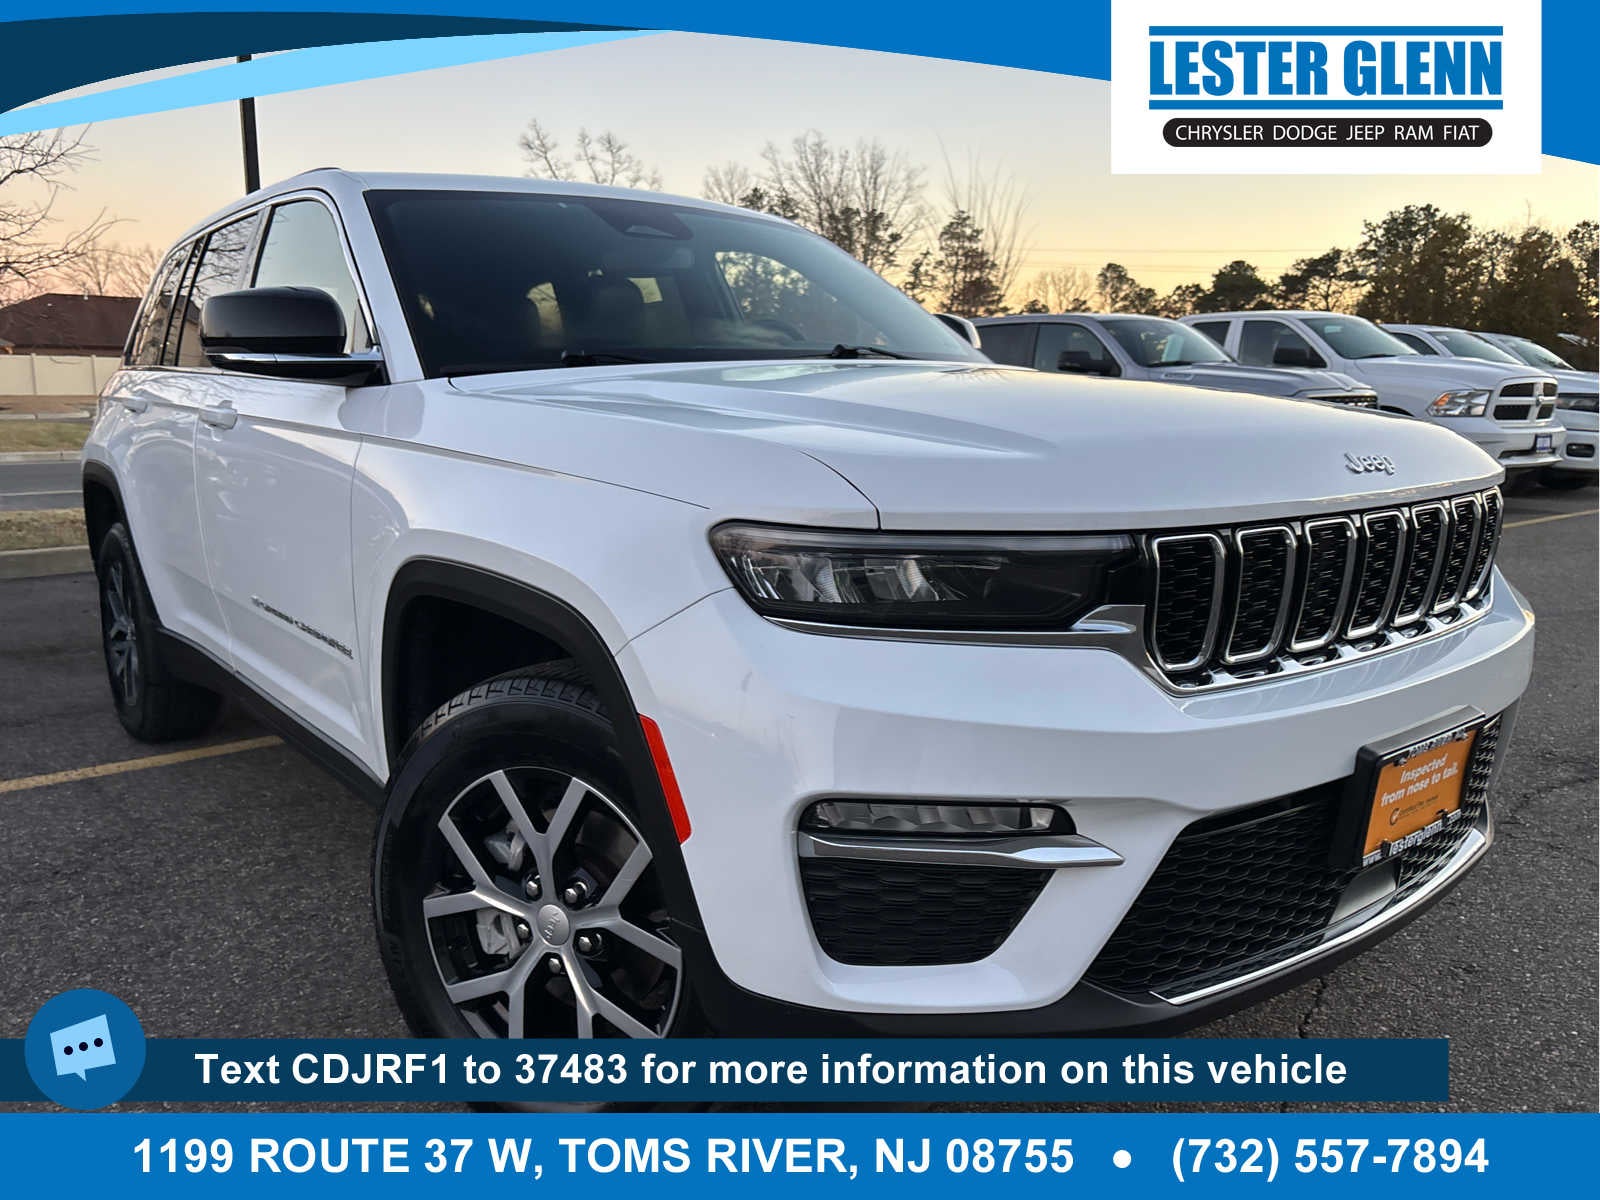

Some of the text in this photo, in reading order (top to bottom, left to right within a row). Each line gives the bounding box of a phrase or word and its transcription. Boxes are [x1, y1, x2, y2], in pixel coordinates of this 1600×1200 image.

[1343, 449, 1396, 476] Jeep
[1400, 753, 1448, 784] Inspected
[1381, 788, 1405, 807] from
[1406, 778, 1430, 796] nose
[1431, 773, 1441, 784] to
